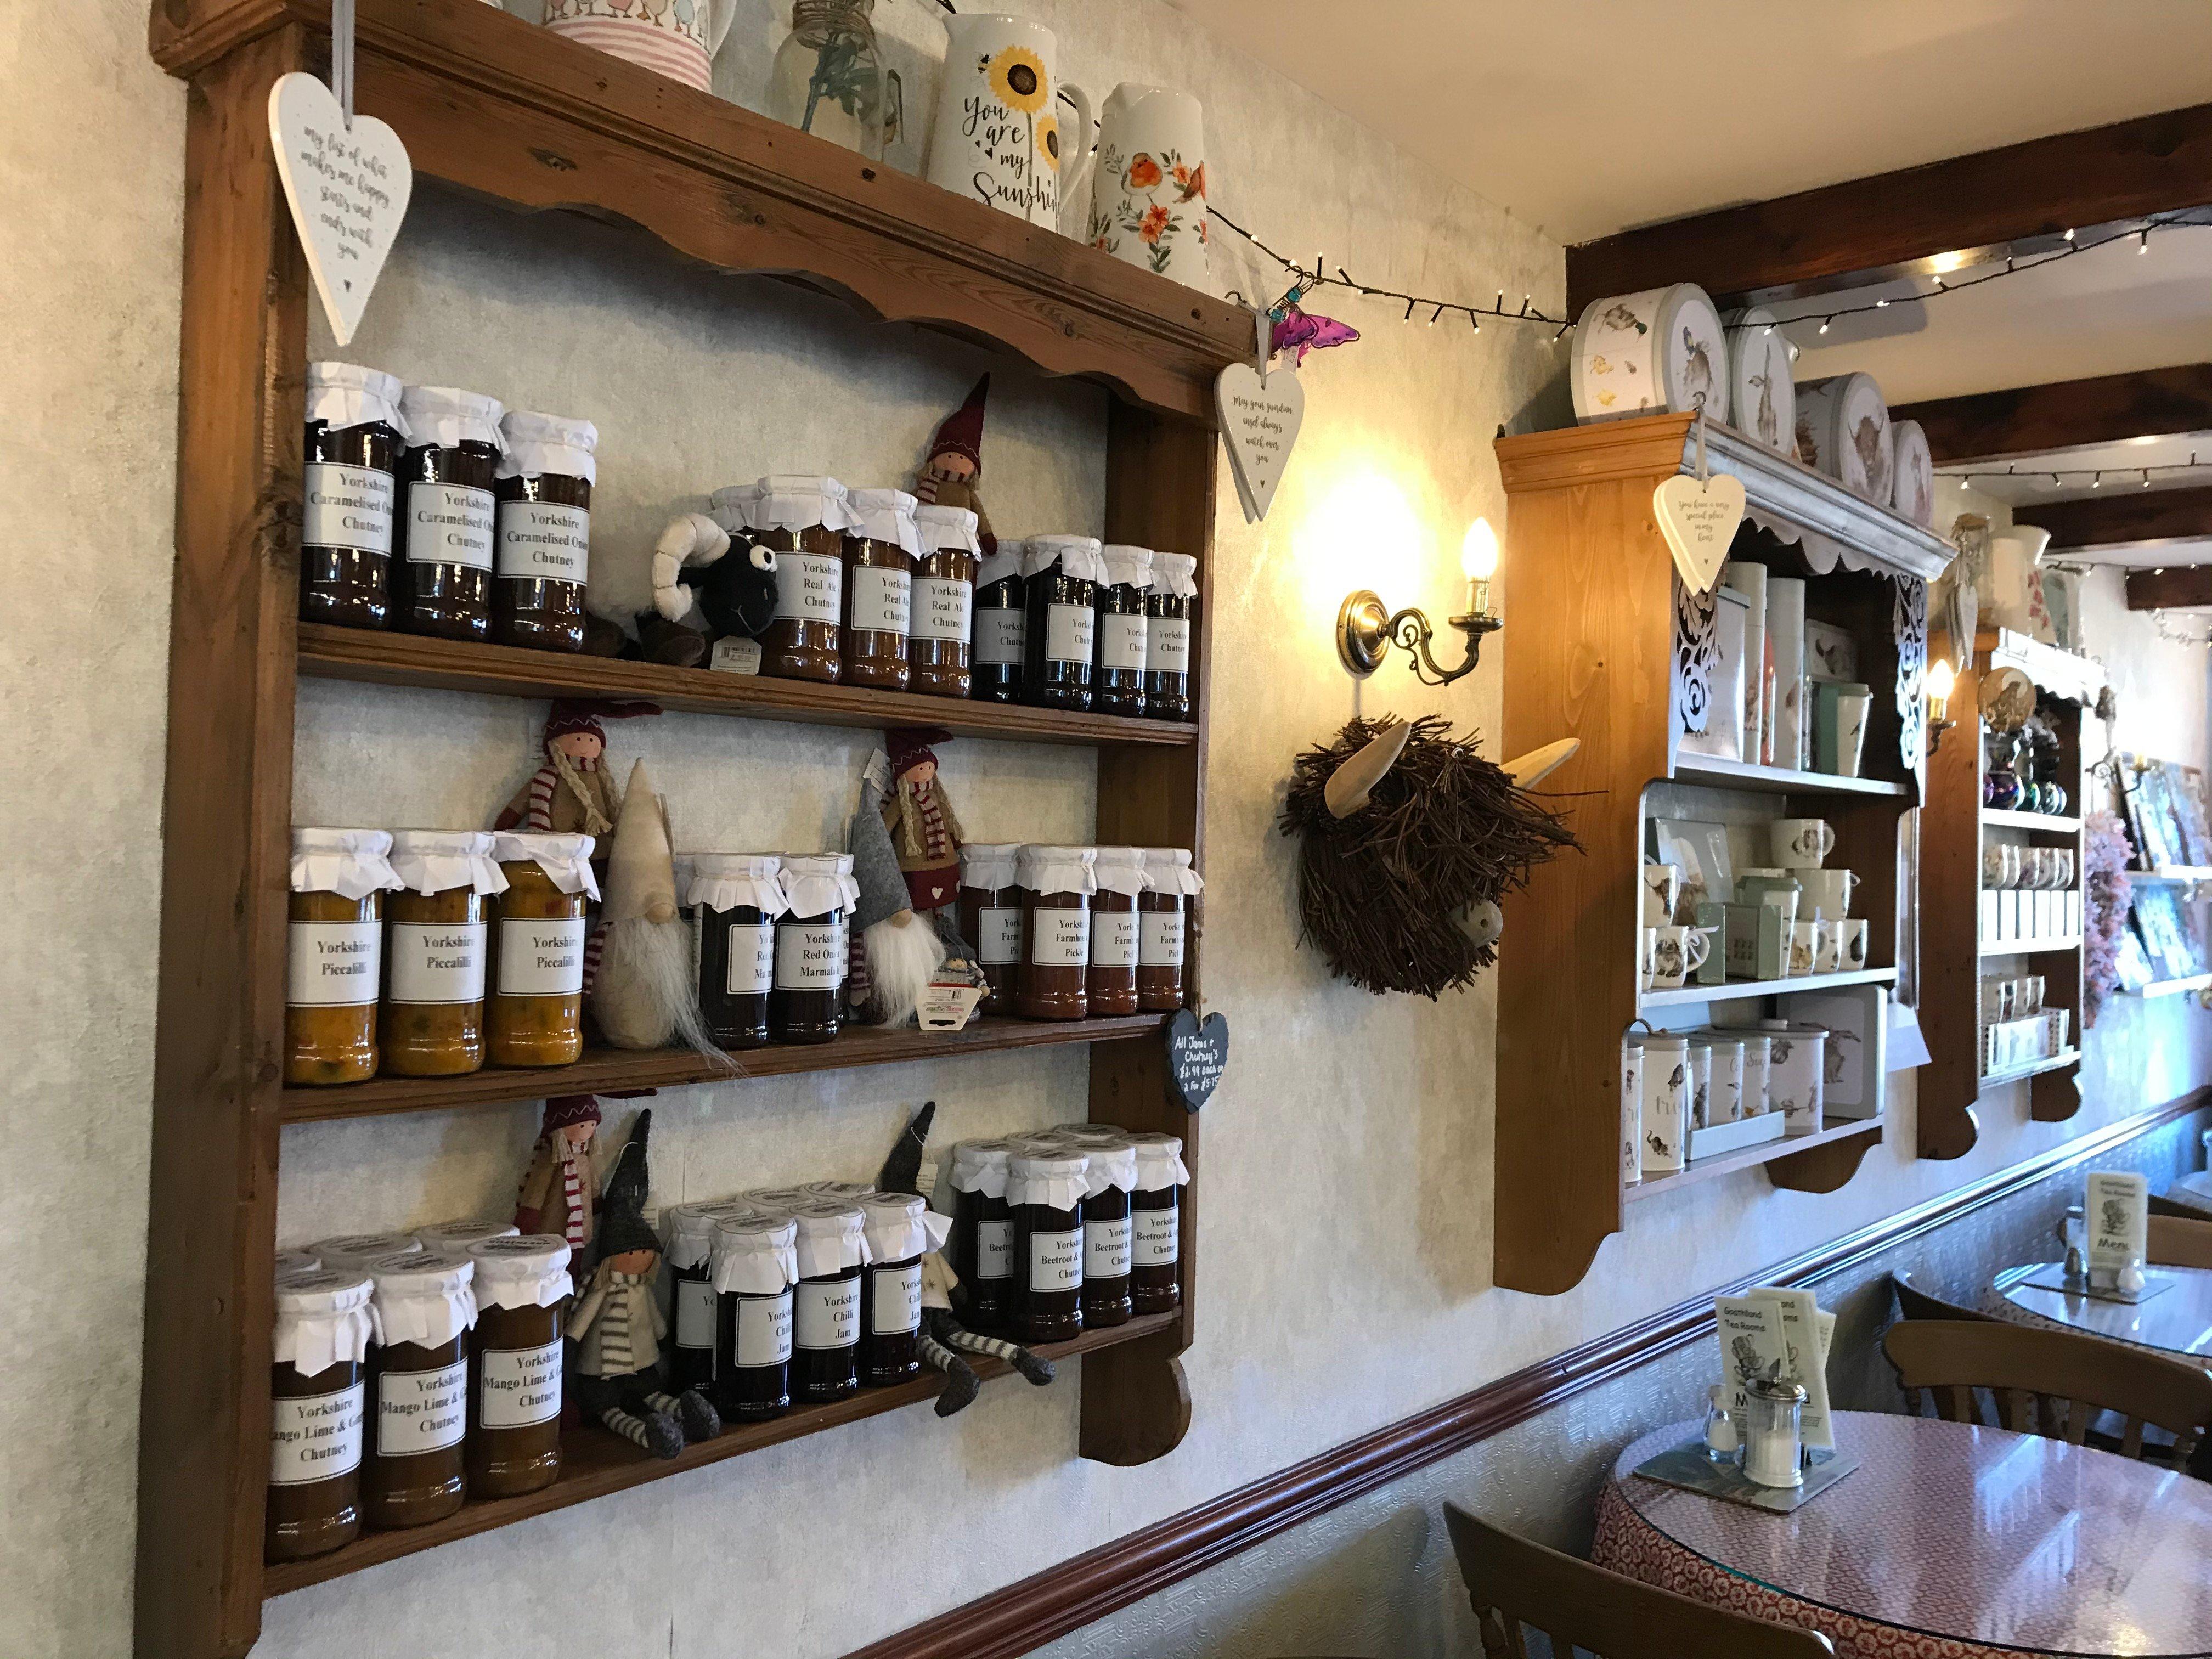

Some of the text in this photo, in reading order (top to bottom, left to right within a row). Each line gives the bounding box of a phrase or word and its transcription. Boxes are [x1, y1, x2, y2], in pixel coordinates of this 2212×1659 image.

[986, 126, 1025, 146] are
[1001, 154, 1030, 179] my
[1233, 396, 1292, 414] May your guardian
[1243, 415, 1282, 434] angel always
[1246, 435, 1280, 451] watch over
[1256, 454, 1268, 465] you
[311, 492, 380, 511] Caramelised
[342, 516, 383, 536] Chutney
[417, 510, 482, 528] Caramelised
[530, 512, 579, 529] Yorkshire
[447, 533, 485, 553] Chutney
[507, 530, 569, 546] Caramelised
[533, 551, 573, 569] Chutney
[803, 562, 838, 577] Yorkshire
[804, 578, 836, 592] Real Ale
[931, 585, 967, 598] Yorkshire
[805, 595, 835, 612] Chutney
[884, 593, 900, 604] Real
[932, 601, 950, 611] Real
[933, 617, 963, 630] Chutney
[1059, 919, 1088, 929] Yorkshe
[423, 935, 475, 948] Yorkshire
[1056, 933, 1088, 942] Farmhoue
[317, 940, 371, 953] Yorkshire
[1065, 948, 1084, 957] Pickle
[427, 956, 471, 968] Piccalilli
[537, 955, 575, 968] Piccalilli
[803, 950, 820, 960] Red
[1175, 1036, 1186, 1050] All
[1189, 1036, 1207, 1049] Jams
[1185, 1049, 1218, 1065] Chutney's
[1202, 1065, 1216, 1075] each
[1184, 1082, 1189, 1092] 2
[1137, 1232, 1166, 1240] Beetroot
[1167, 1229, 1172, 1238] &
[1095, 1242, 1124, 1251] Beetroot
[1042, 1255, 1072, 1265] Beetroot
[1074, 1252, 1078, 1261] &
[824, 1294, 858, 1306] Yorkshire
[833, 1310, 853, 1322] Chilli
[1724, 1319, 1765, 1332] Tea Rooms
[835, 1329, 850, 1339] Jam
[777, 1344, 789, 1354] Jam
[517, 1350, 559, 1369] Yorkshire
[416, 1372, 463, 1392] Yorkshire
[483, 1377, 520, 1391] Mango
[523, 1374, 547, 1387] Lime
[549, 1369, 555, 1381] &
[424, 1398, 449, 1411] Lime
[451, 1391, 458, 1404] &
[520, 1390, 556, 1407] Chutney
[297, 1399, 353, 1418] Yorkshire
[273, 1431, 300, 1444] ango
[304, 1425, 335, 1439] Lime
[337, 1419, 346, 1432] &
[300, 1443, 347, 1462] Chutney
